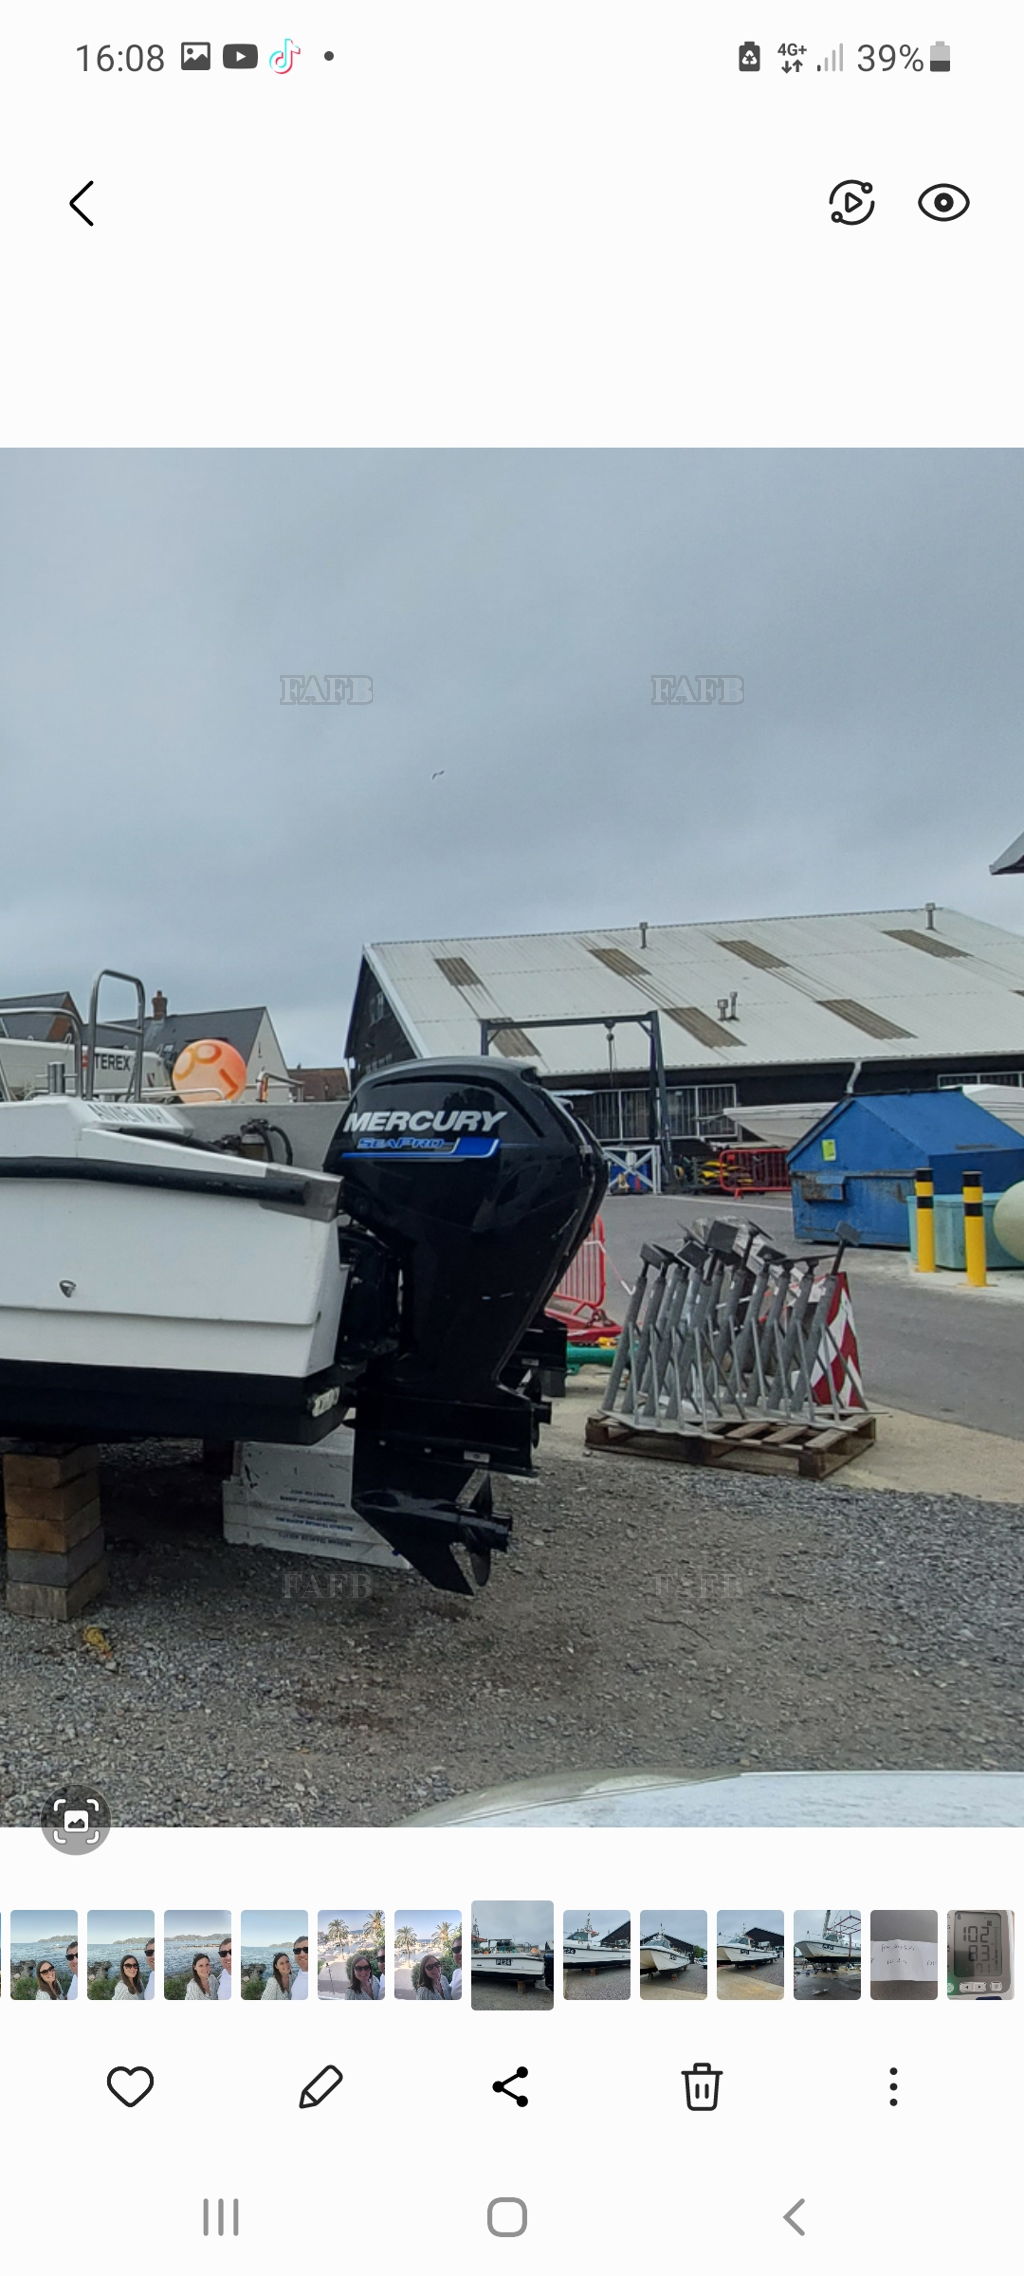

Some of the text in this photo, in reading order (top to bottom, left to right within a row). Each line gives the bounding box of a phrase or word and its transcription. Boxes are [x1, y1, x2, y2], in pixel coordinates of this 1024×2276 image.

[76, 43, 164, 72] 16:08
[777, 43, 807, 56] 4G+
[857, 43, 924, 72] 39%
[95, 1054, 131, 1072] TEREX
[343, 1110, 507, 1132] MERCURY
